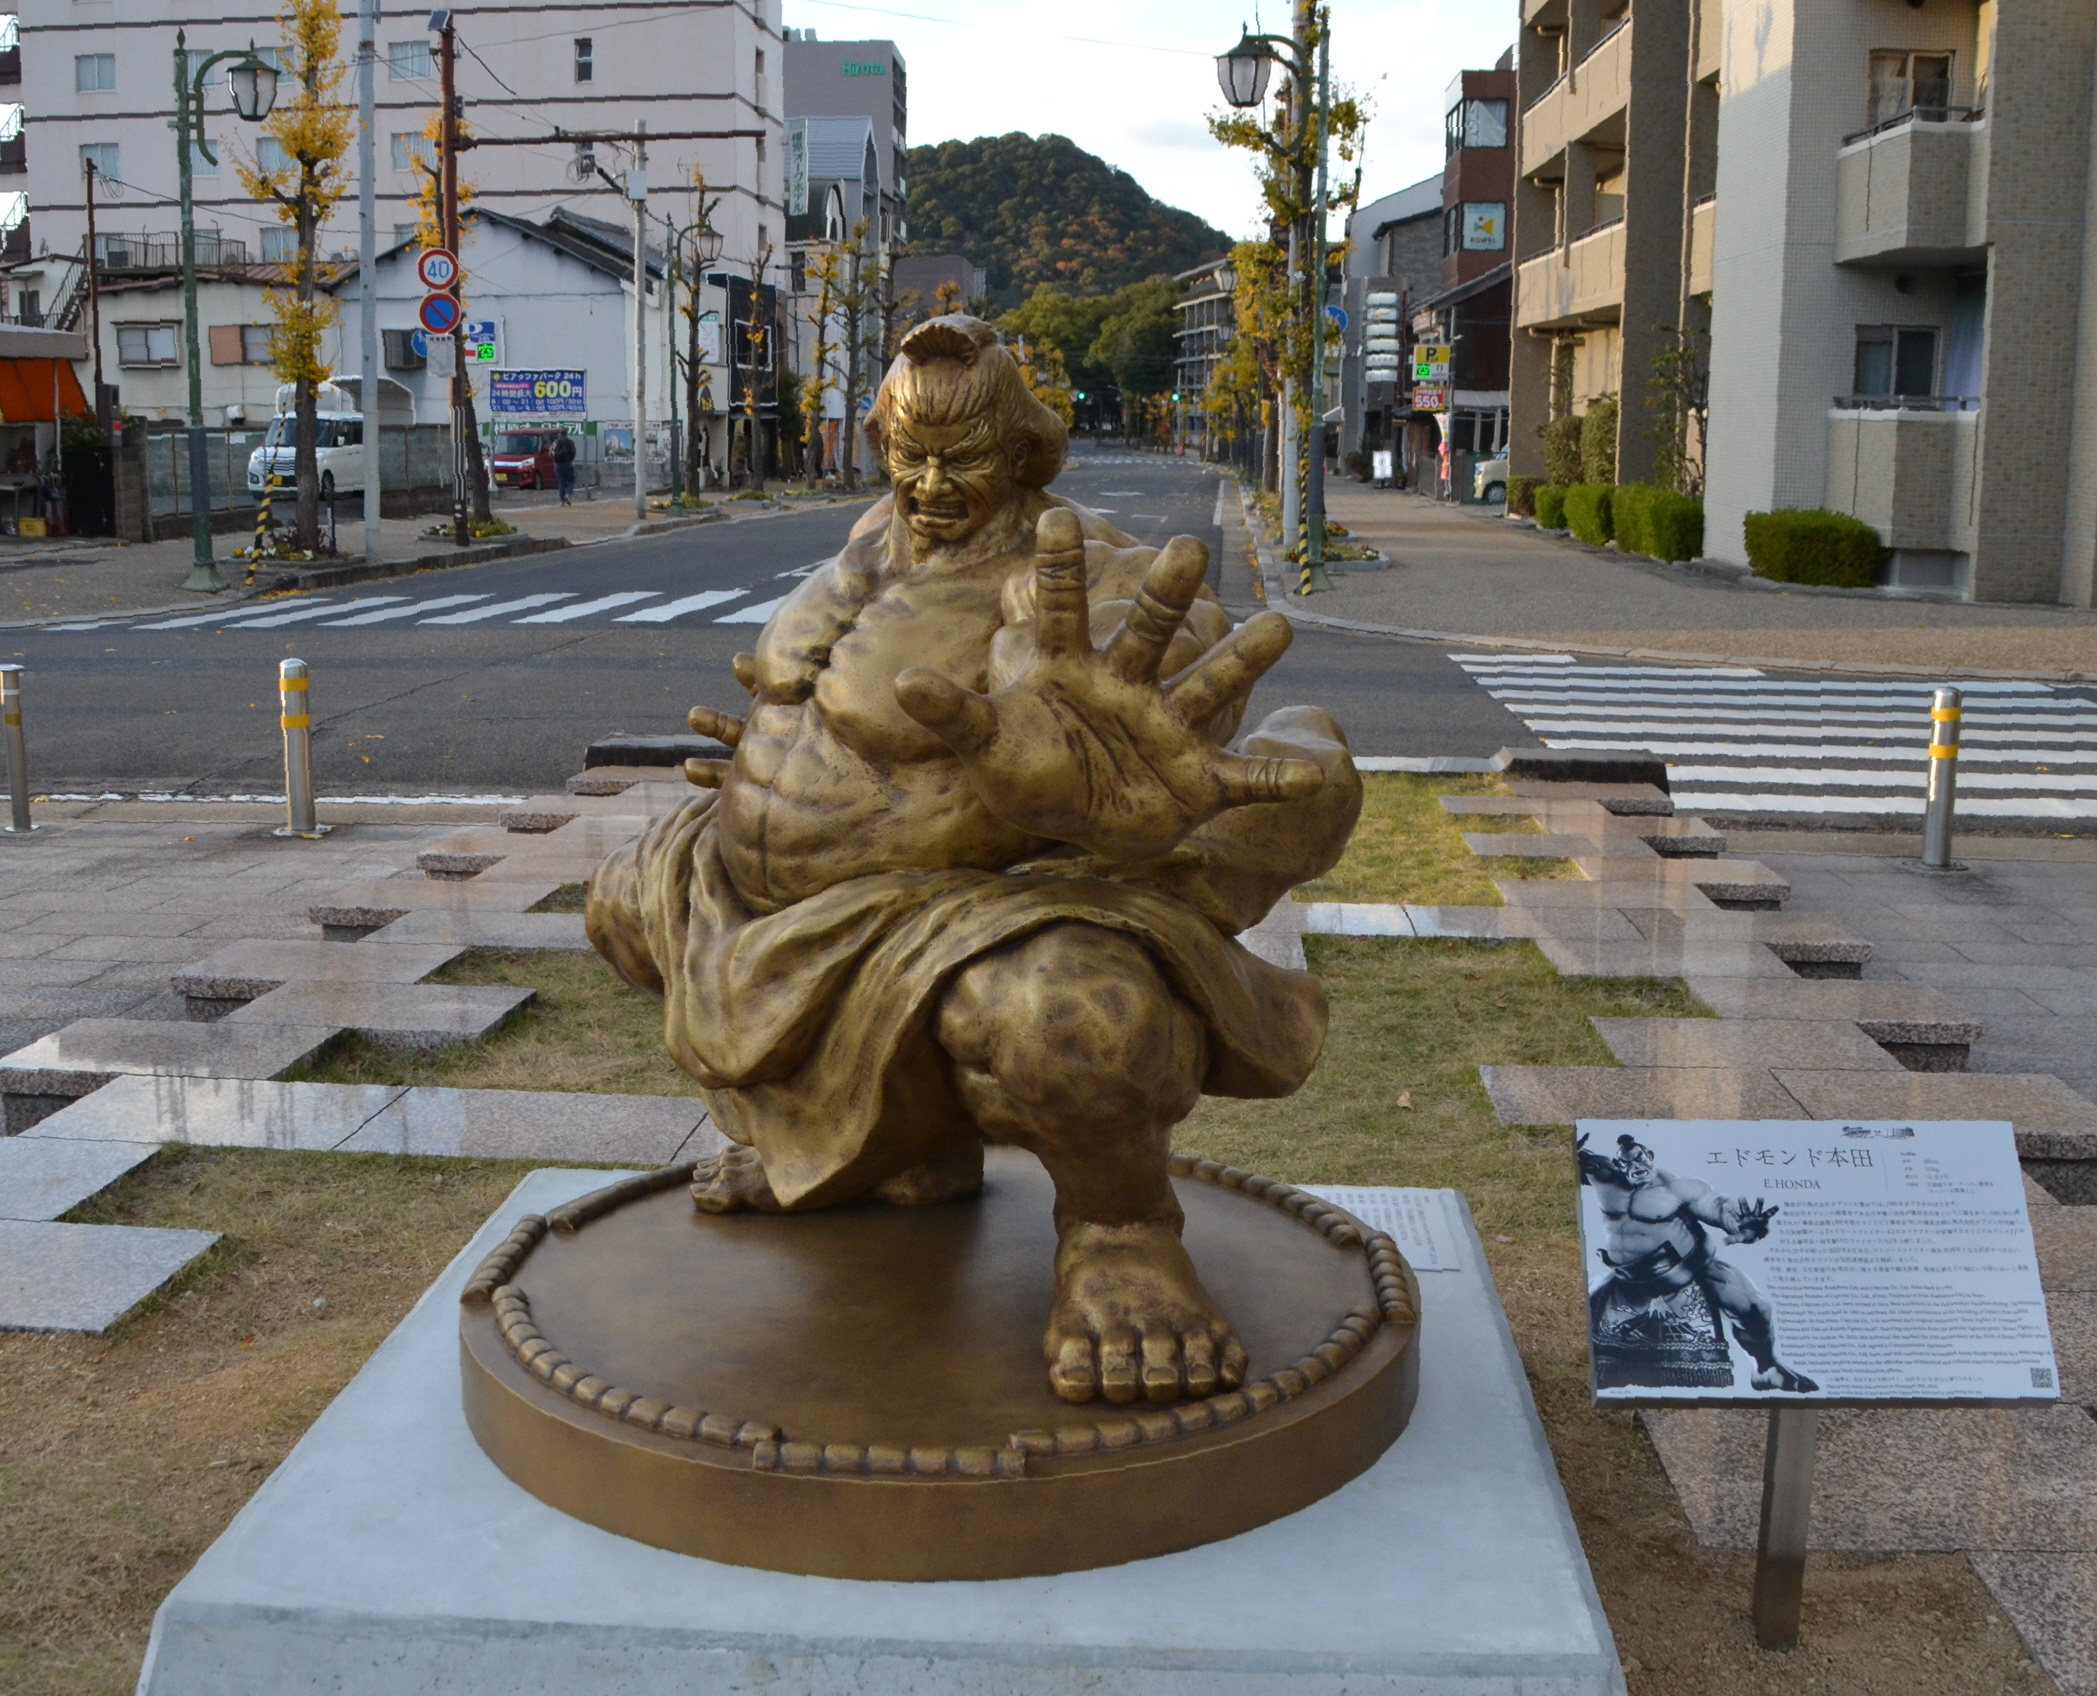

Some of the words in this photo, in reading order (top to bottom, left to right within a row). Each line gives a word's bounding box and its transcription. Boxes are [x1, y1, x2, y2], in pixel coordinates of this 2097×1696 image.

[841, 60, 884, 75] Hirota
[428, 261, 449, 278] 40
[1426, 347, 1437, 362] P
[1707, 1147, 1873, 1167] エドモンド本田
[1776, 1179, 1821, 1189] HONDA
